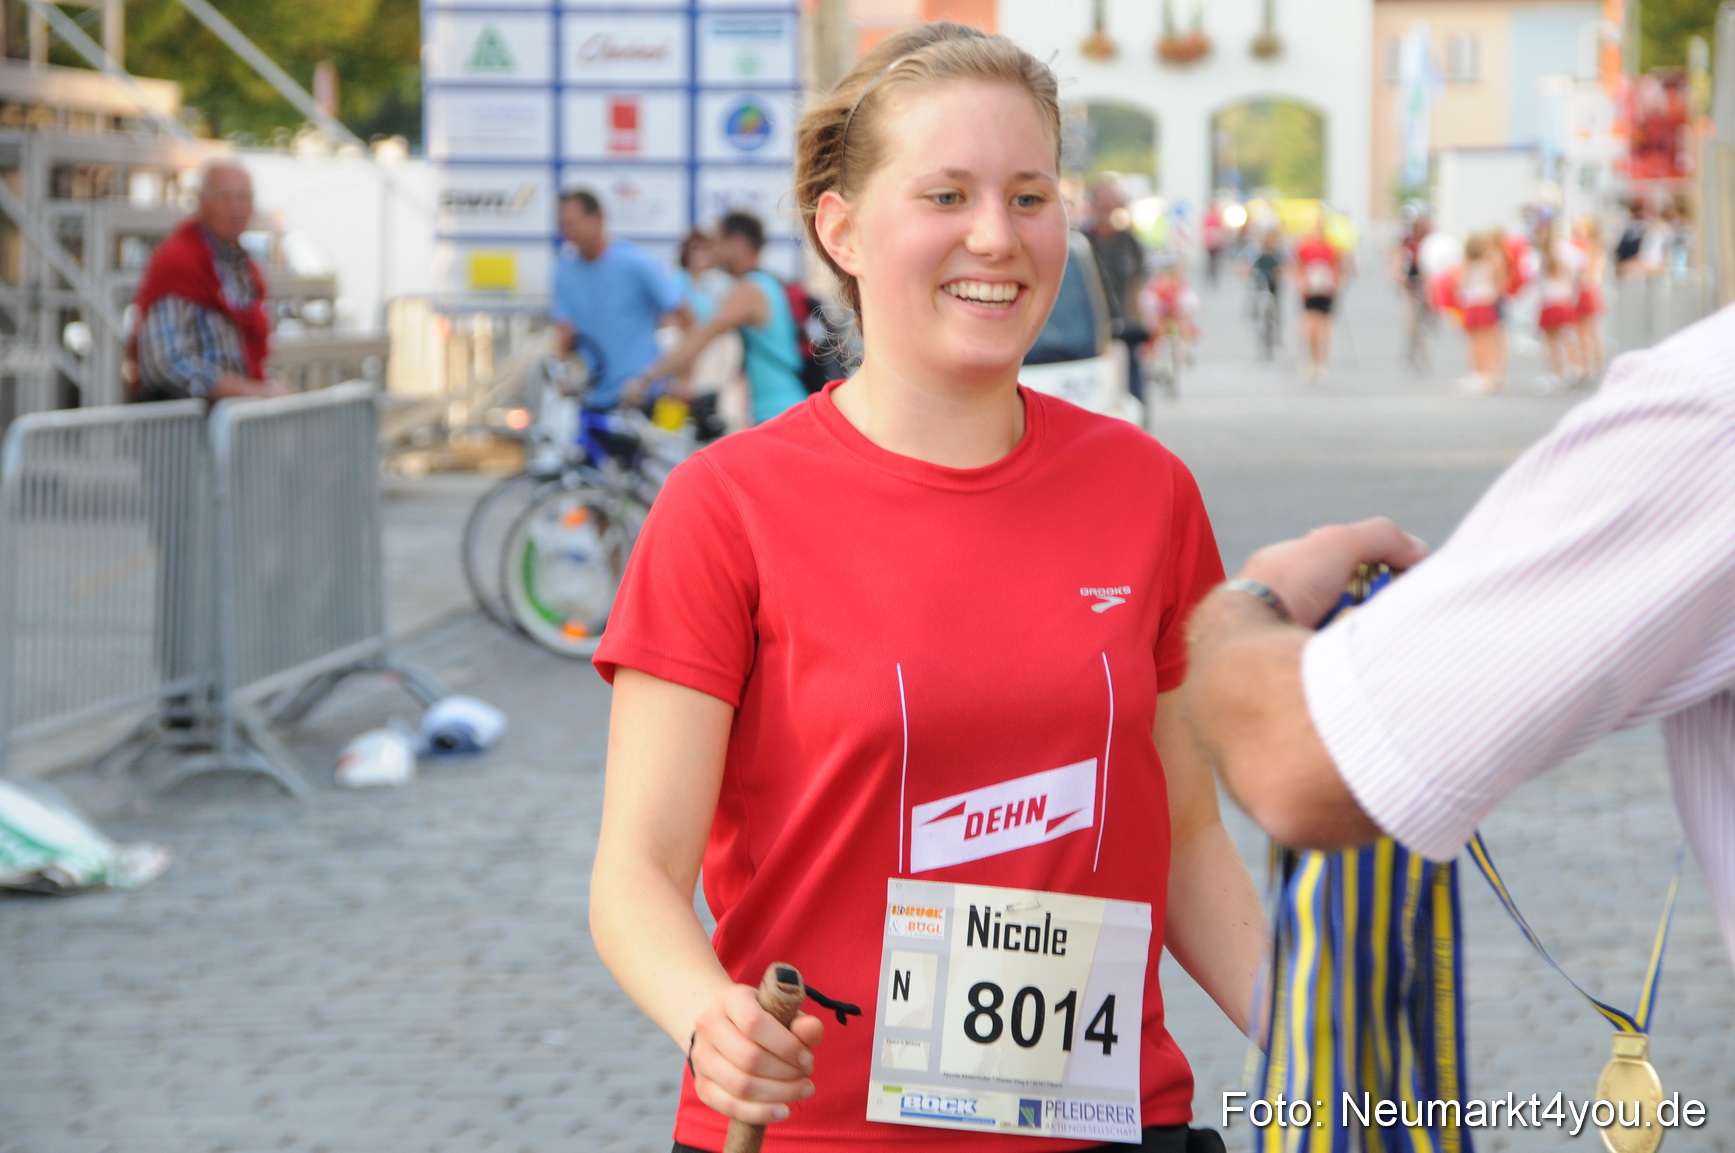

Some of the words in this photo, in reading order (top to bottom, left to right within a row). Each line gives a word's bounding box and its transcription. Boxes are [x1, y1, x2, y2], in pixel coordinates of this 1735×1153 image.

[1080, 585, 1132, 597] BROOKS
[963, 794, 1048, 842] DEHN
[966, 904, 1068, 956] Nicole
[892, 969, 911, 1002] N
[963, 981, 1118, 1056] 8014
[900, 1093, 978, 1117] BOCK
[1045, 1100, 1136, 1125] PFLEIDERER
